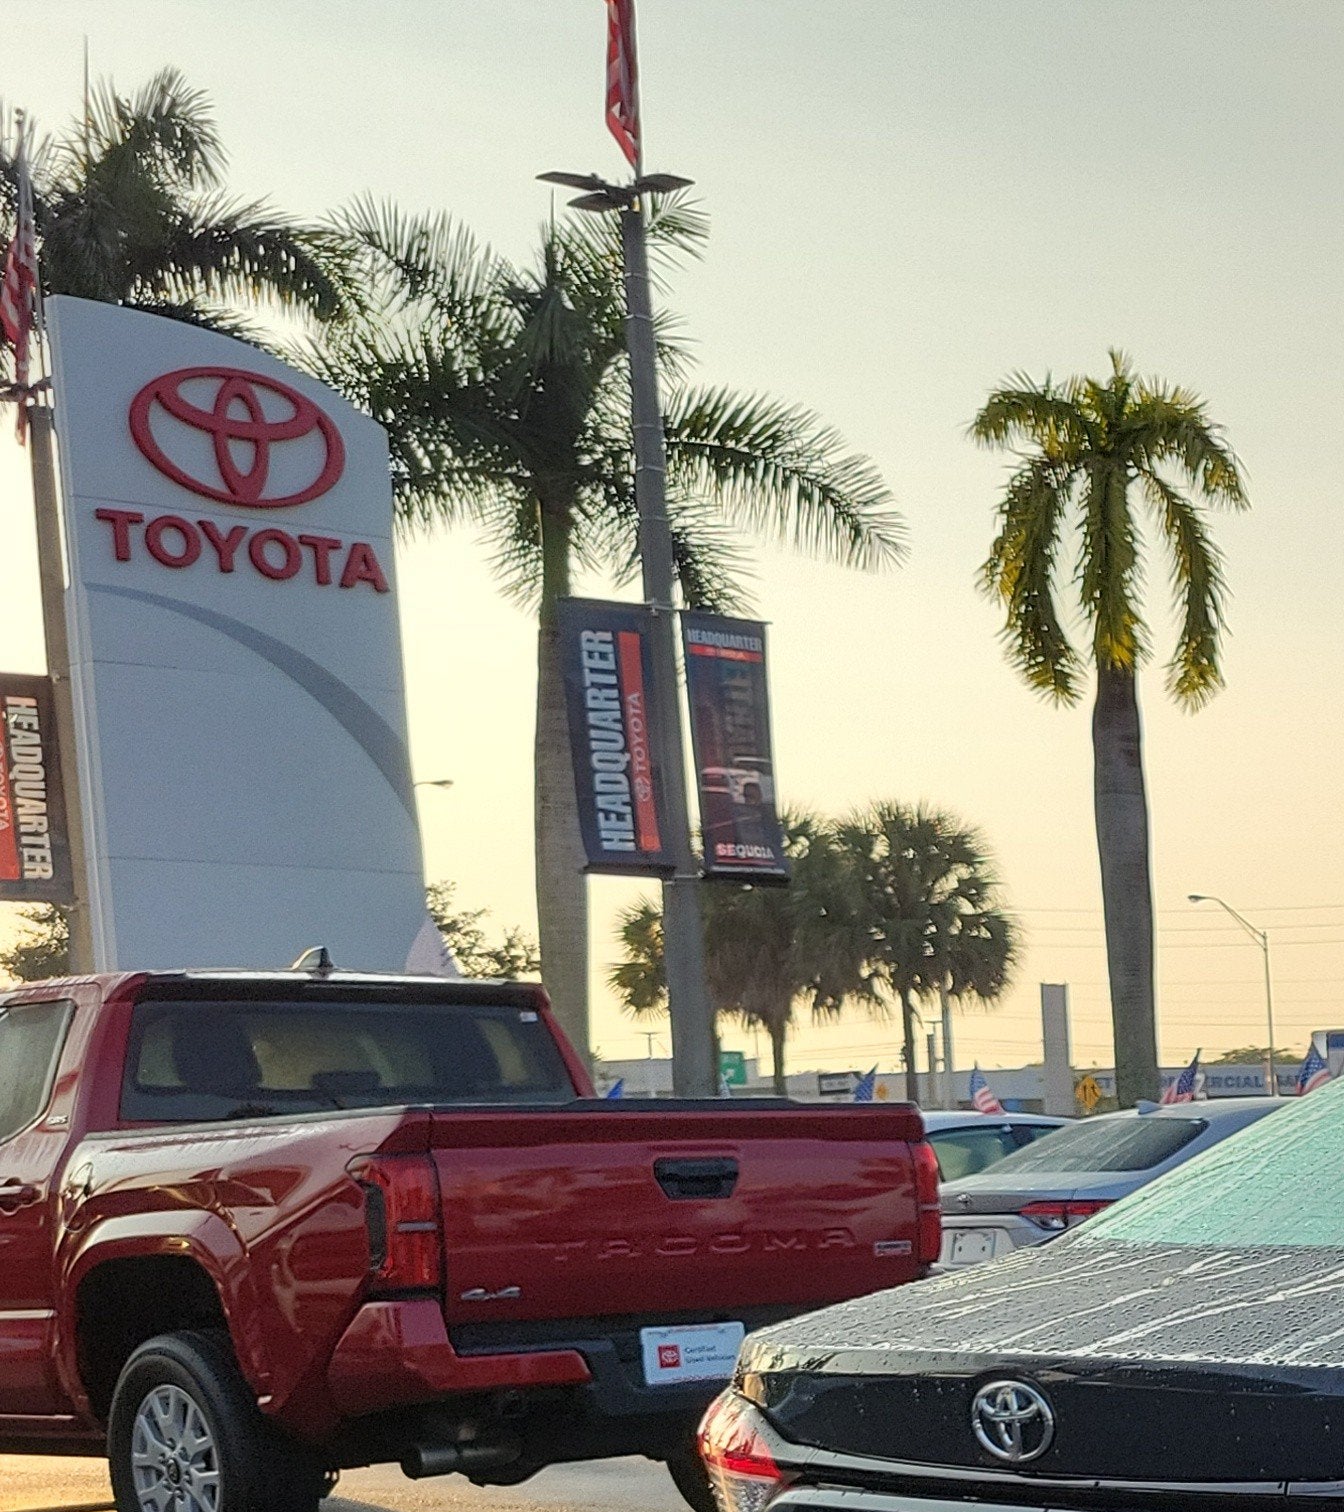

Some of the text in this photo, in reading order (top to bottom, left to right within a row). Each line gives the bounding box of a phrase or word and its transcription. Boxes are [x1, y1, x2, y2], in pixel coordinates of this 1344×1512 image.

[95, 507, 390, 594] TOYOTA
[687, 628, 765, 652] HEADQUARTER
[581, 630, 637, 851] HEADQUARTER
[626, 692, 651, 773] TOYOTA
[6, 697, 54, 880] HEADQUARTER
[716, 843, 775, 859] SEQUOIA
